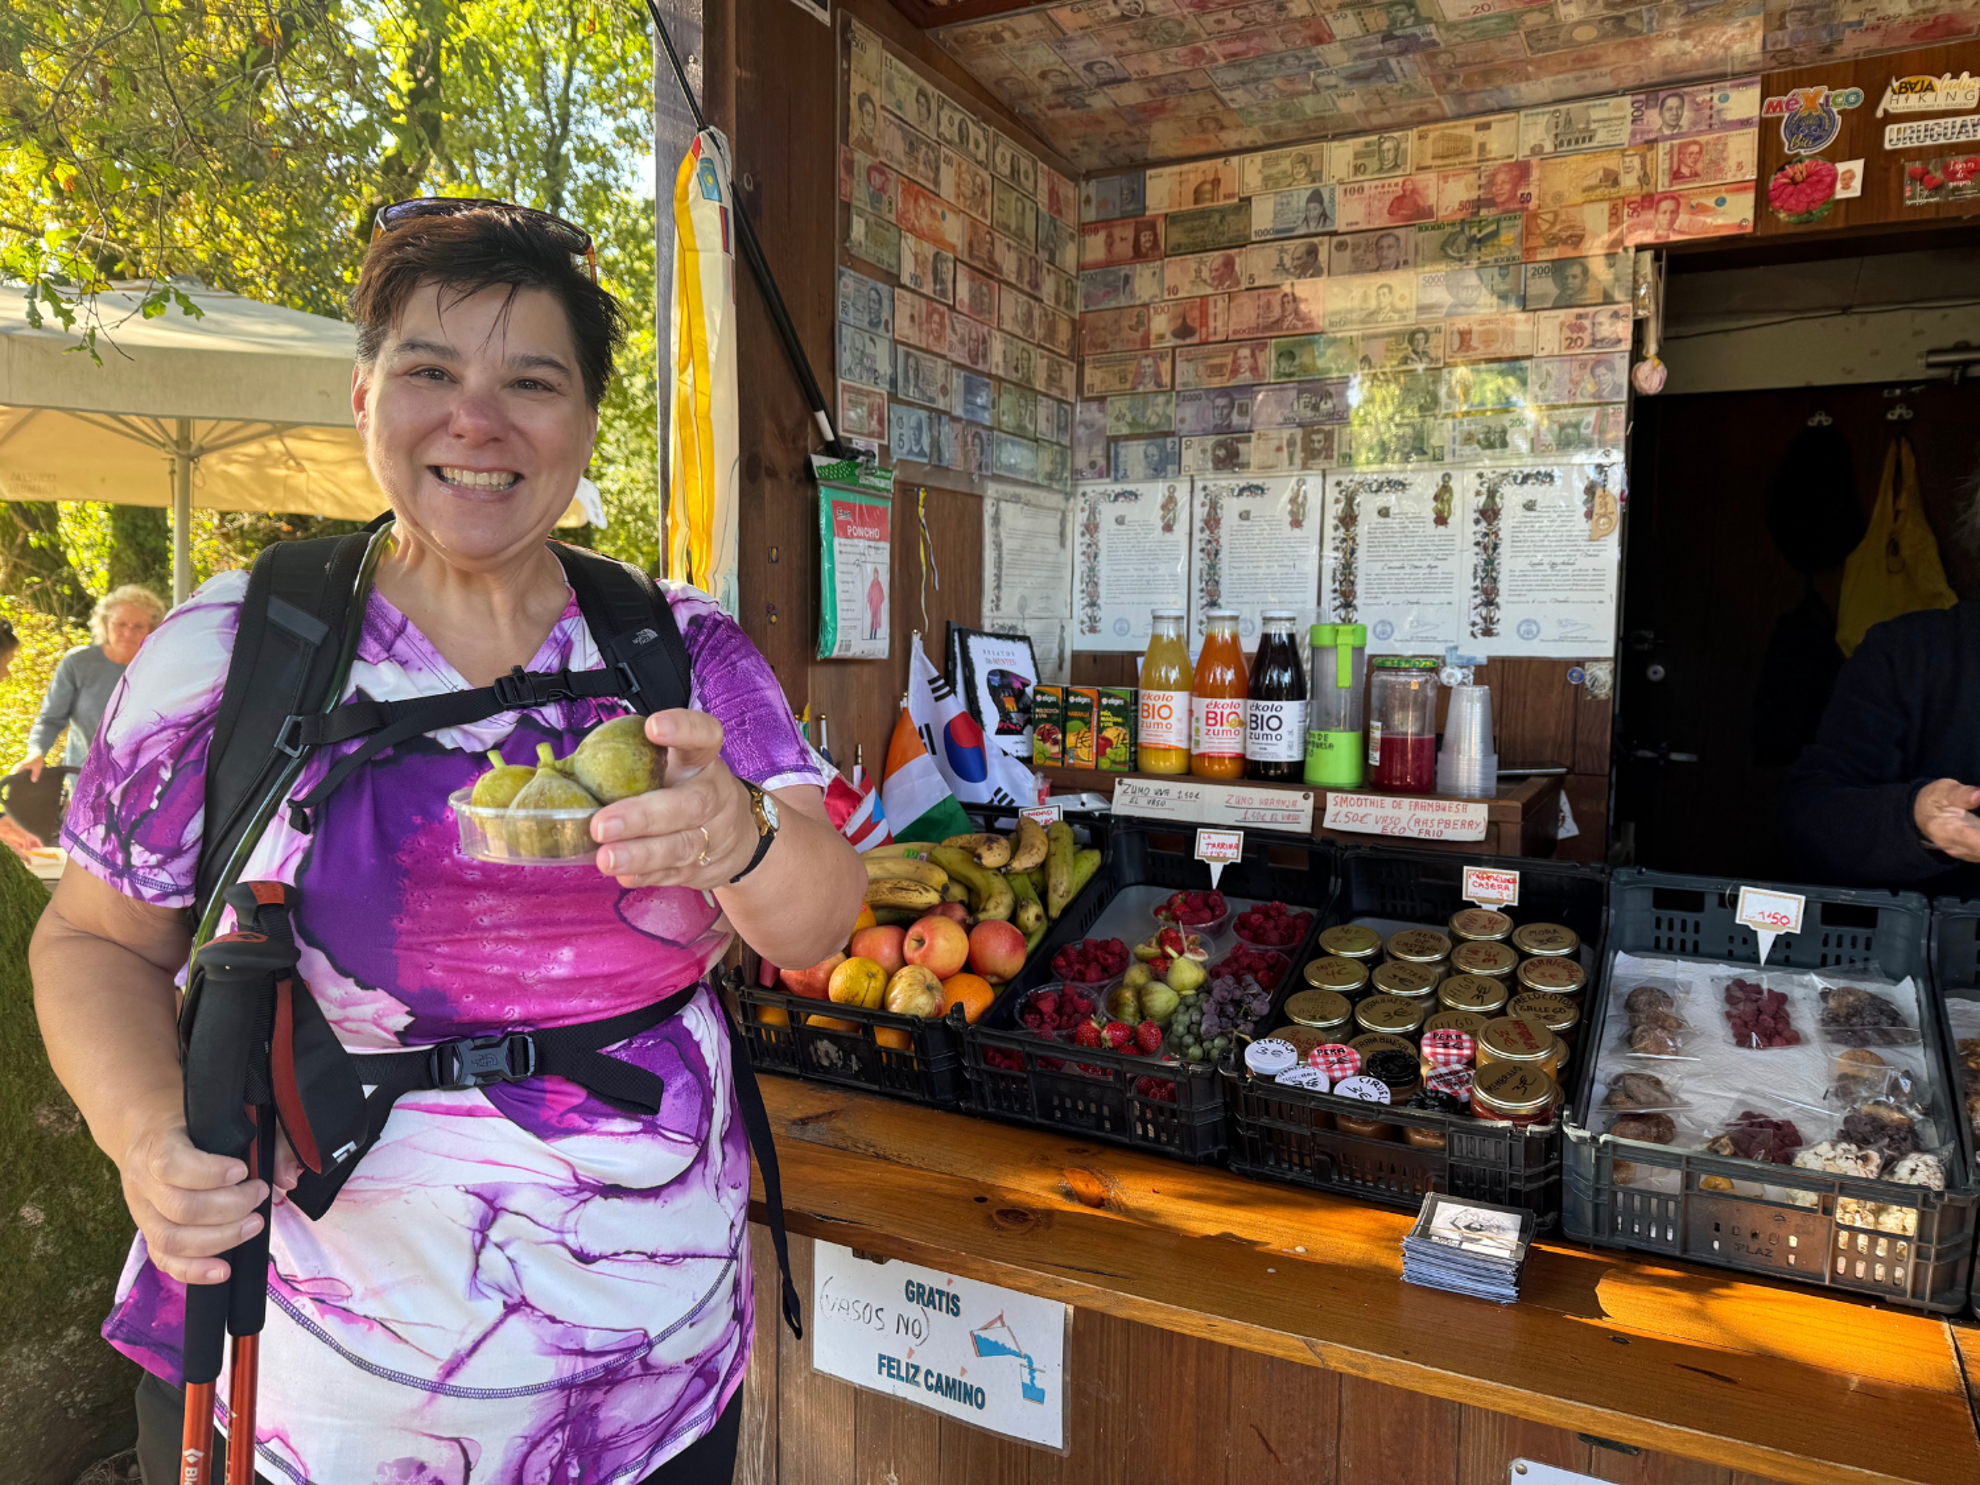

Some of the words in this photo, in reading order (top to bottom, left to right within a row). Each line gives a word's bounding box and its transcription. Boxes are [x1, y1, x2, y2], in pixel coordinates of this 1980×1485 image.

[1470, 2, 1492, 16] 20
[1890, 89, 1976, 105] HIKING
[1353, 162, 1367, 177] 10
[1343, 185, 1365, 198] 100
[1519, 192, 1533, 204] 50
[1458, 200, 1471, 212] 50
[1627, 200, 1641, 219] 50
[1253, 227, 1276, 239] 1000
[1247, 274, 1256, 286] 5
[1165, 284, 1180, 297] 10
[1152, 304, 1171, 316] 100
[1564, 336, 1585, 350] 20
[846, 525, 880, 540] PONCHO
[1141, 693, 1174, 703] ékolo
[1205, 700, 1241, 710] ékolo
[1249, 702, 1284, 713] ékolo
[1141, 702, 1174, 721] BIO
[1205, 710, 1241, 728] BIO
[1249, 713, 1284, 732] BIO
[1140, 721, 1174, 731] zumo
[1205, 728, 1242, 738] zumo
[1249, 731, 1284, 742] zumo
[1122, 782, 1150, 796] ZUMO
[1225, 794, 1254, 806] ZUMO
[1333, 795, 1386, 810] SMOOTHIE
[1391, 799, 1404, 810] DE
[1408, 800, 1469, 814] FRAMBUESA
[1330, 810, 1372, 825] 1.50€
[1374, 814, 1401, 826] VASO
[1407, 813, 1488, 834] (RASPBERRY)
[1381, 825, 1407, 836] ECO
[1472, 880, 1510, 892] CASERA
[1528, 928, 1560, 938] MORA
[1315, 961, 1344, 972] MIEL
[905, 1279, 961, 1318] GRATIS
[877, 1353, 921, 1387] FELIZ
[924, 1369, 986, 1411] CAMINO
